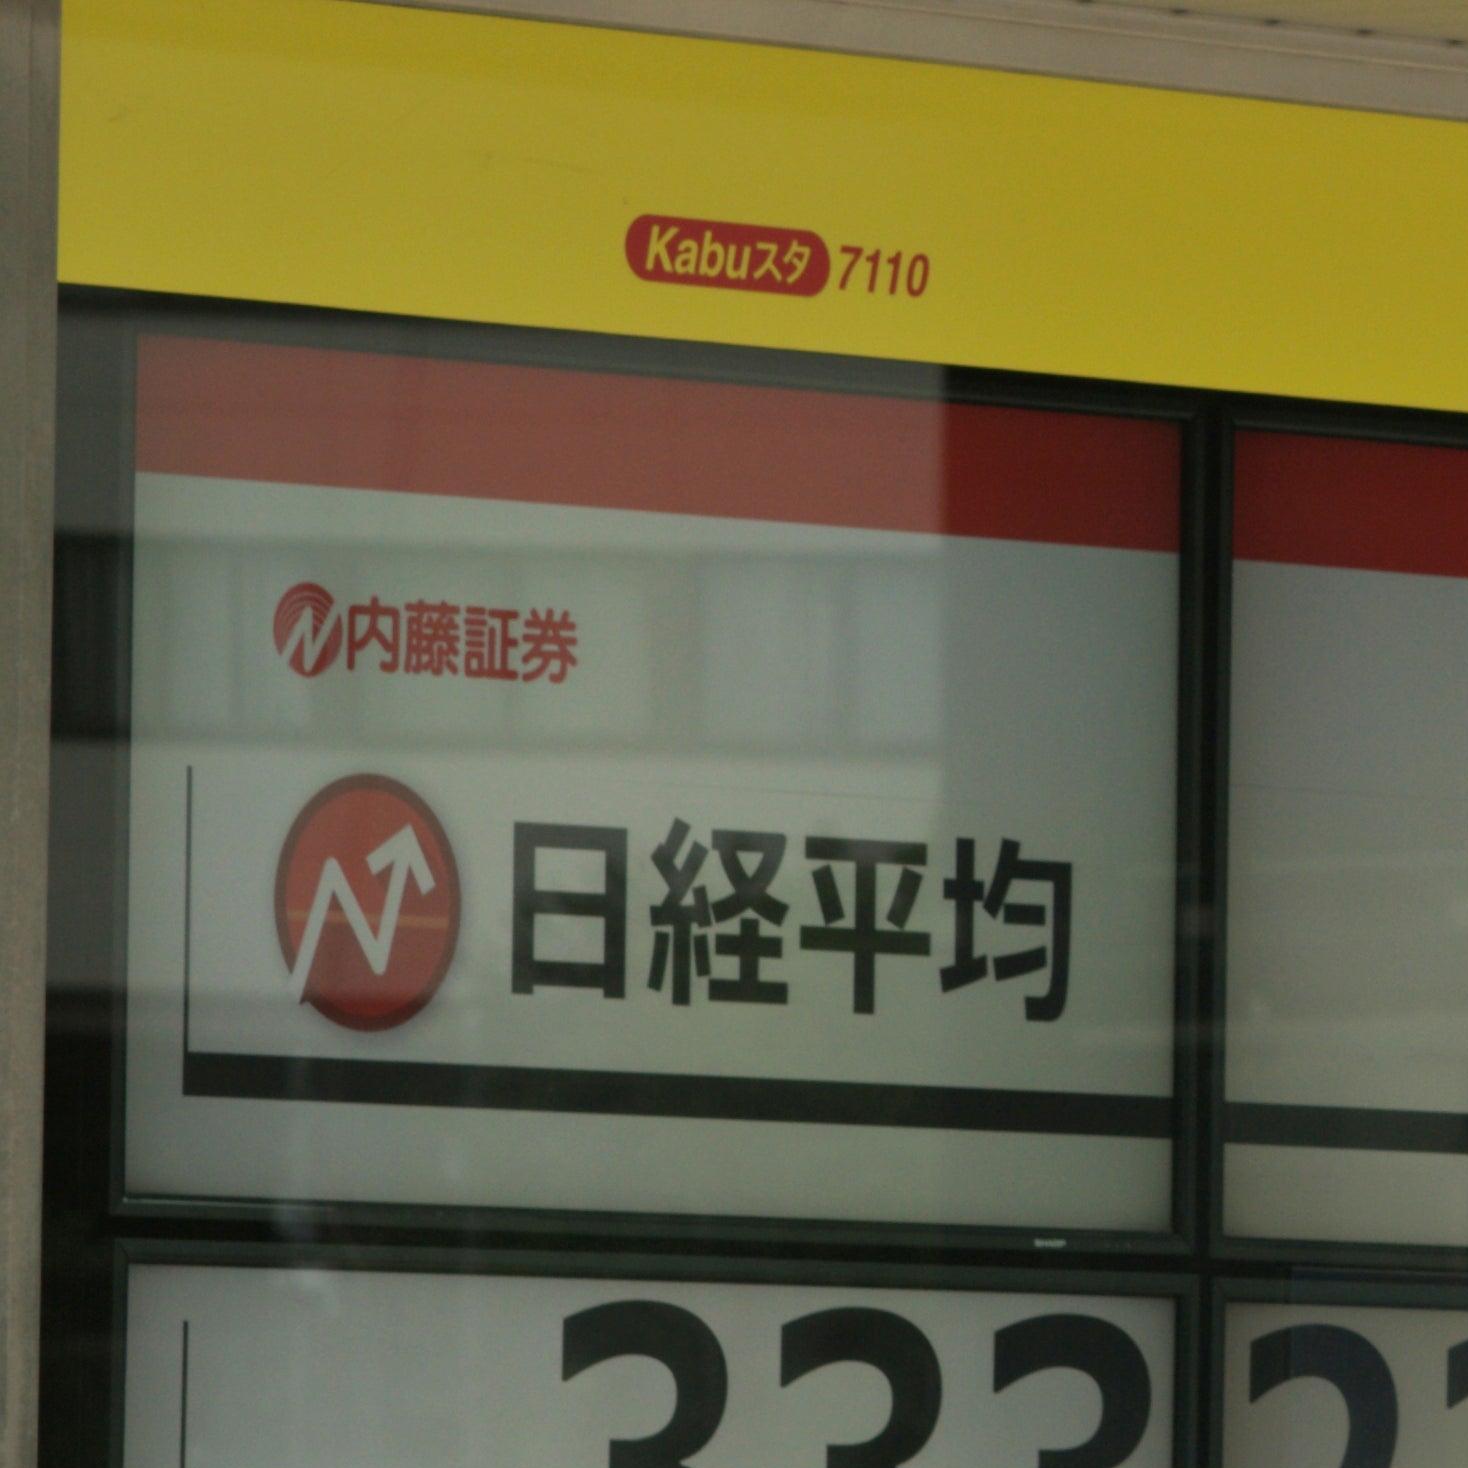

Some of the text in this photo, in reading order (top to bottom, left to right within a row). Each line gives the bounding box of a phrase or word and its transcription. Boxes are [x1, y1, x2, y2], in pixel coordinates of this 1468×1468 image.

[645, 224, 930, 298] Kabuスタ 7110
[346, 595, 578, 684] 内藤証券
[511, 817, 1073, 1023] 日経平均
